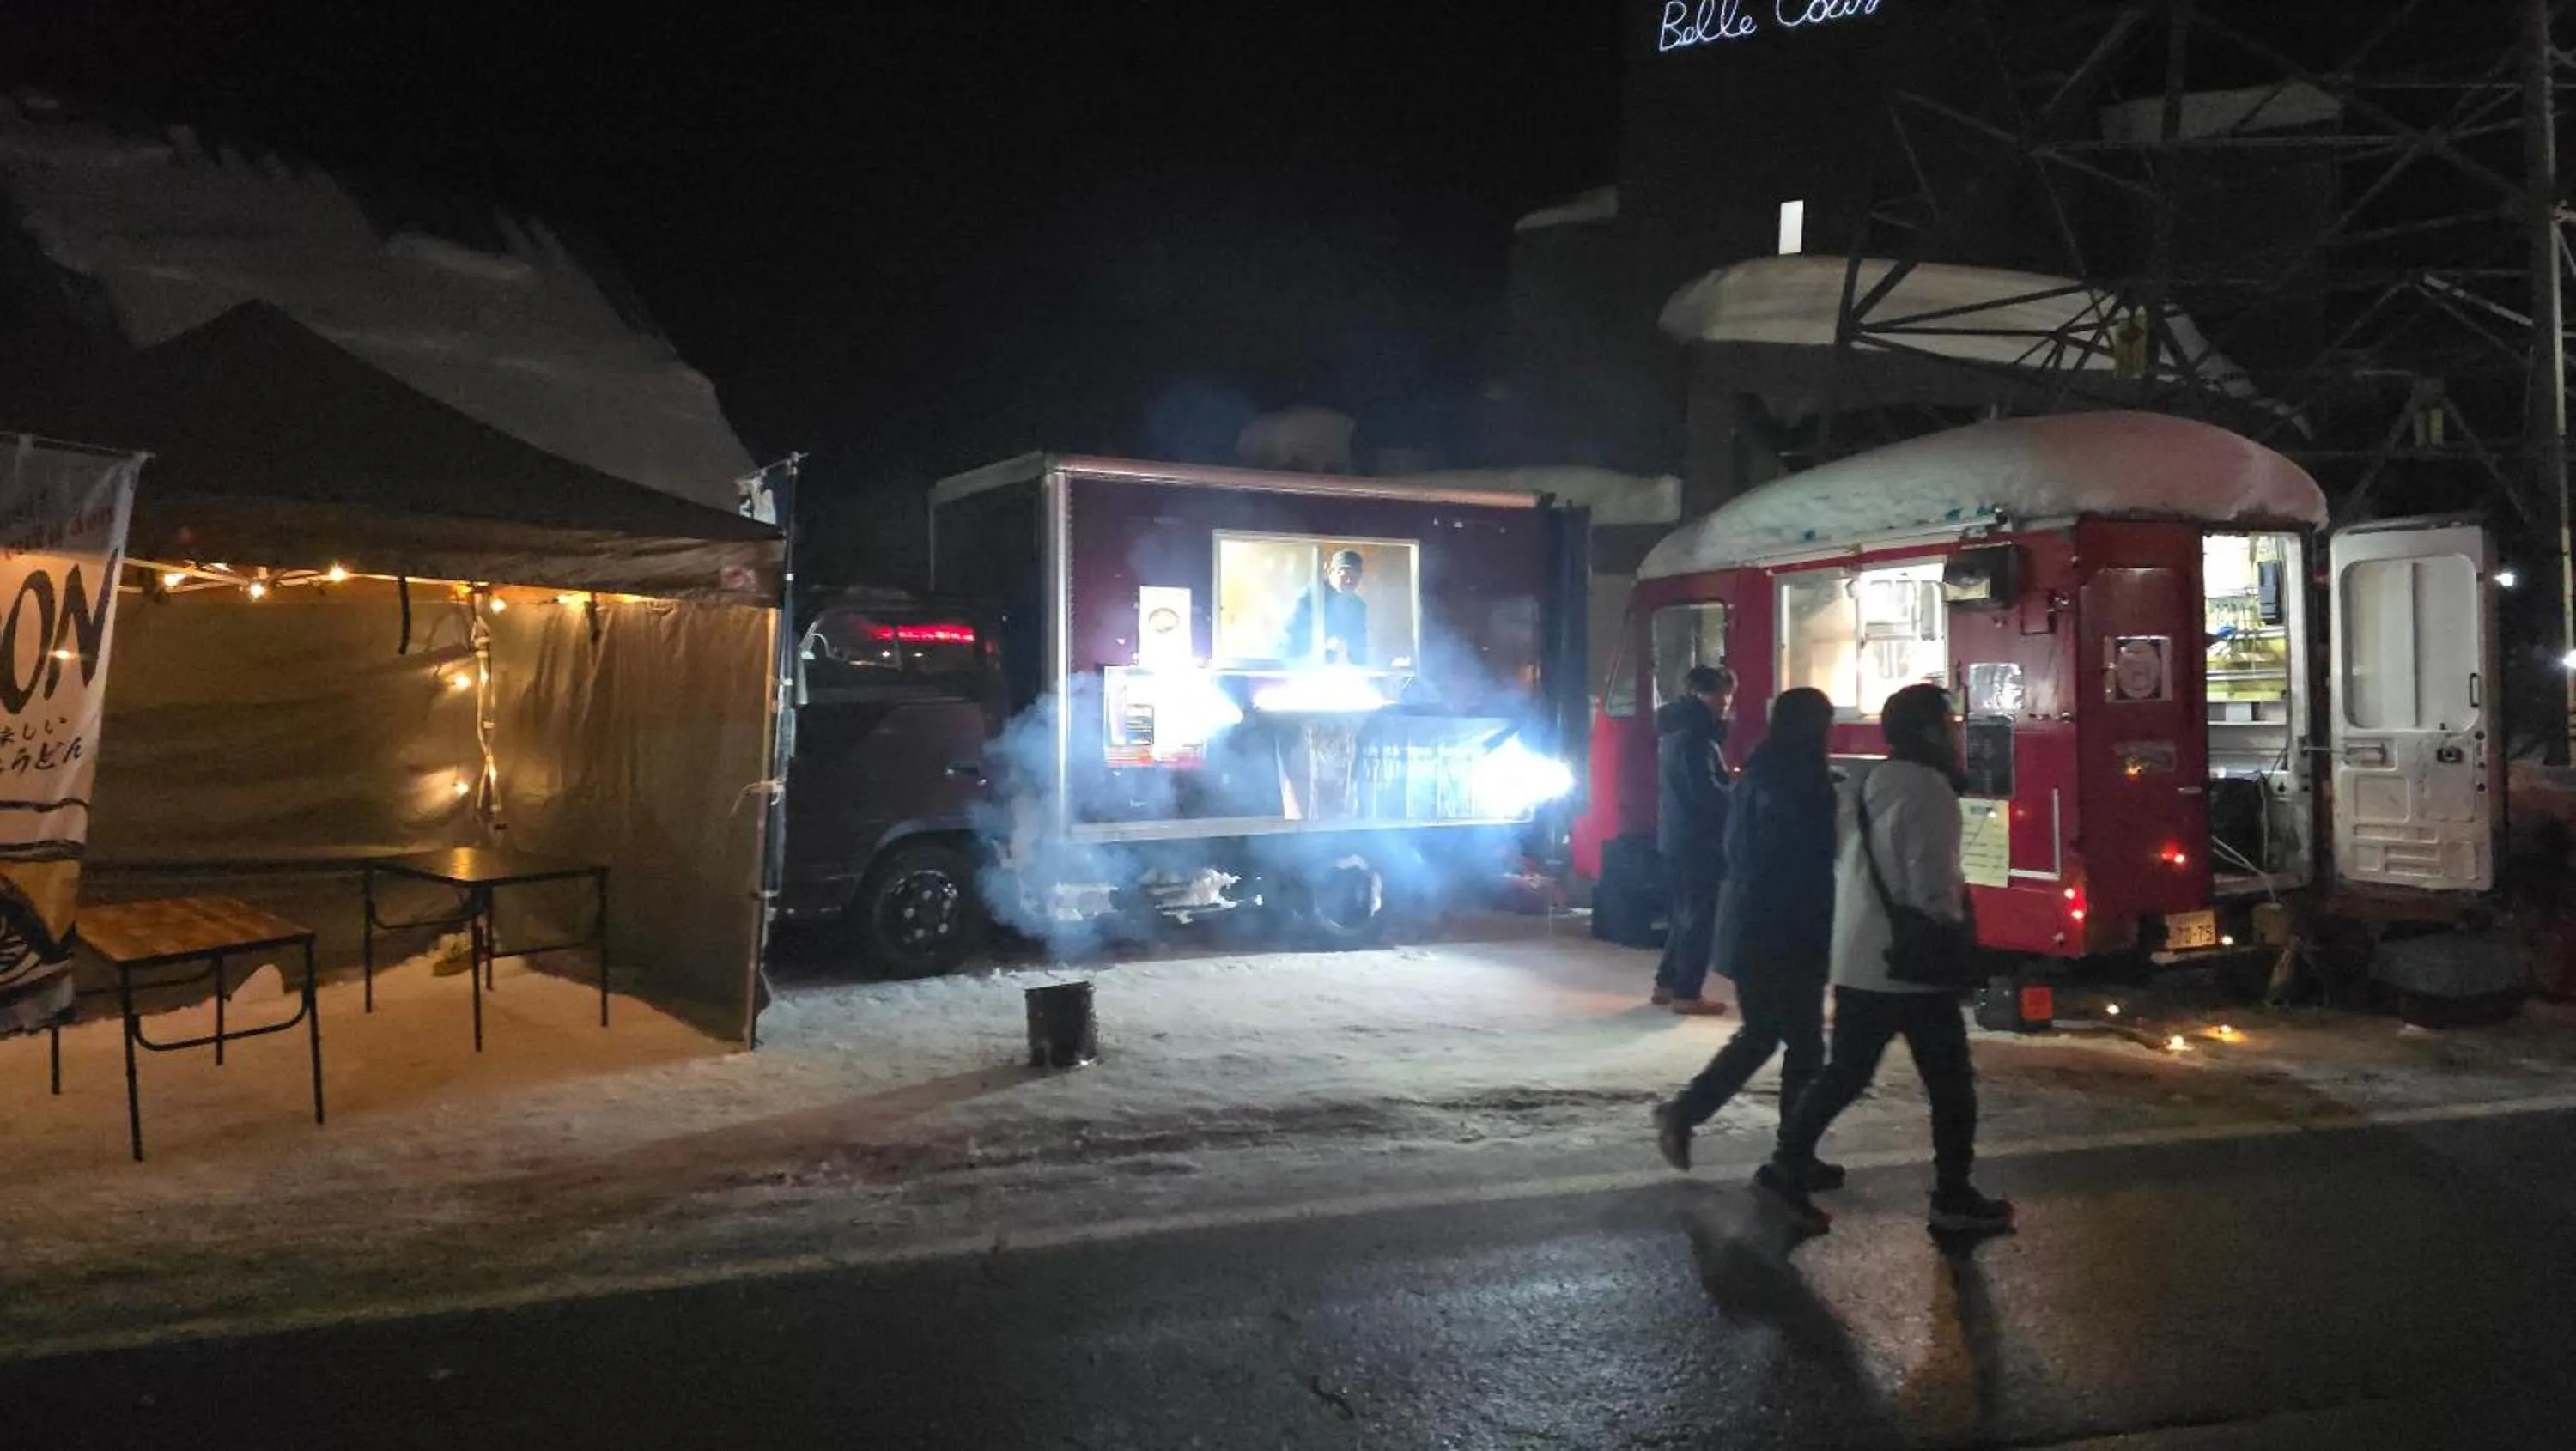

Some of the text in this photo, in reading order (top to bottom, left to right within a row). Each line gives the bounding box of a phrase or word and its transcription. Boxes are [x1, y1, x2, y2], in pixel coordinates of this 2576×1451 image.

[1658, 0, 1757, 52] Belle
[0, 548, 119, 715] ON
[0, 736, 82, 777] うどん
